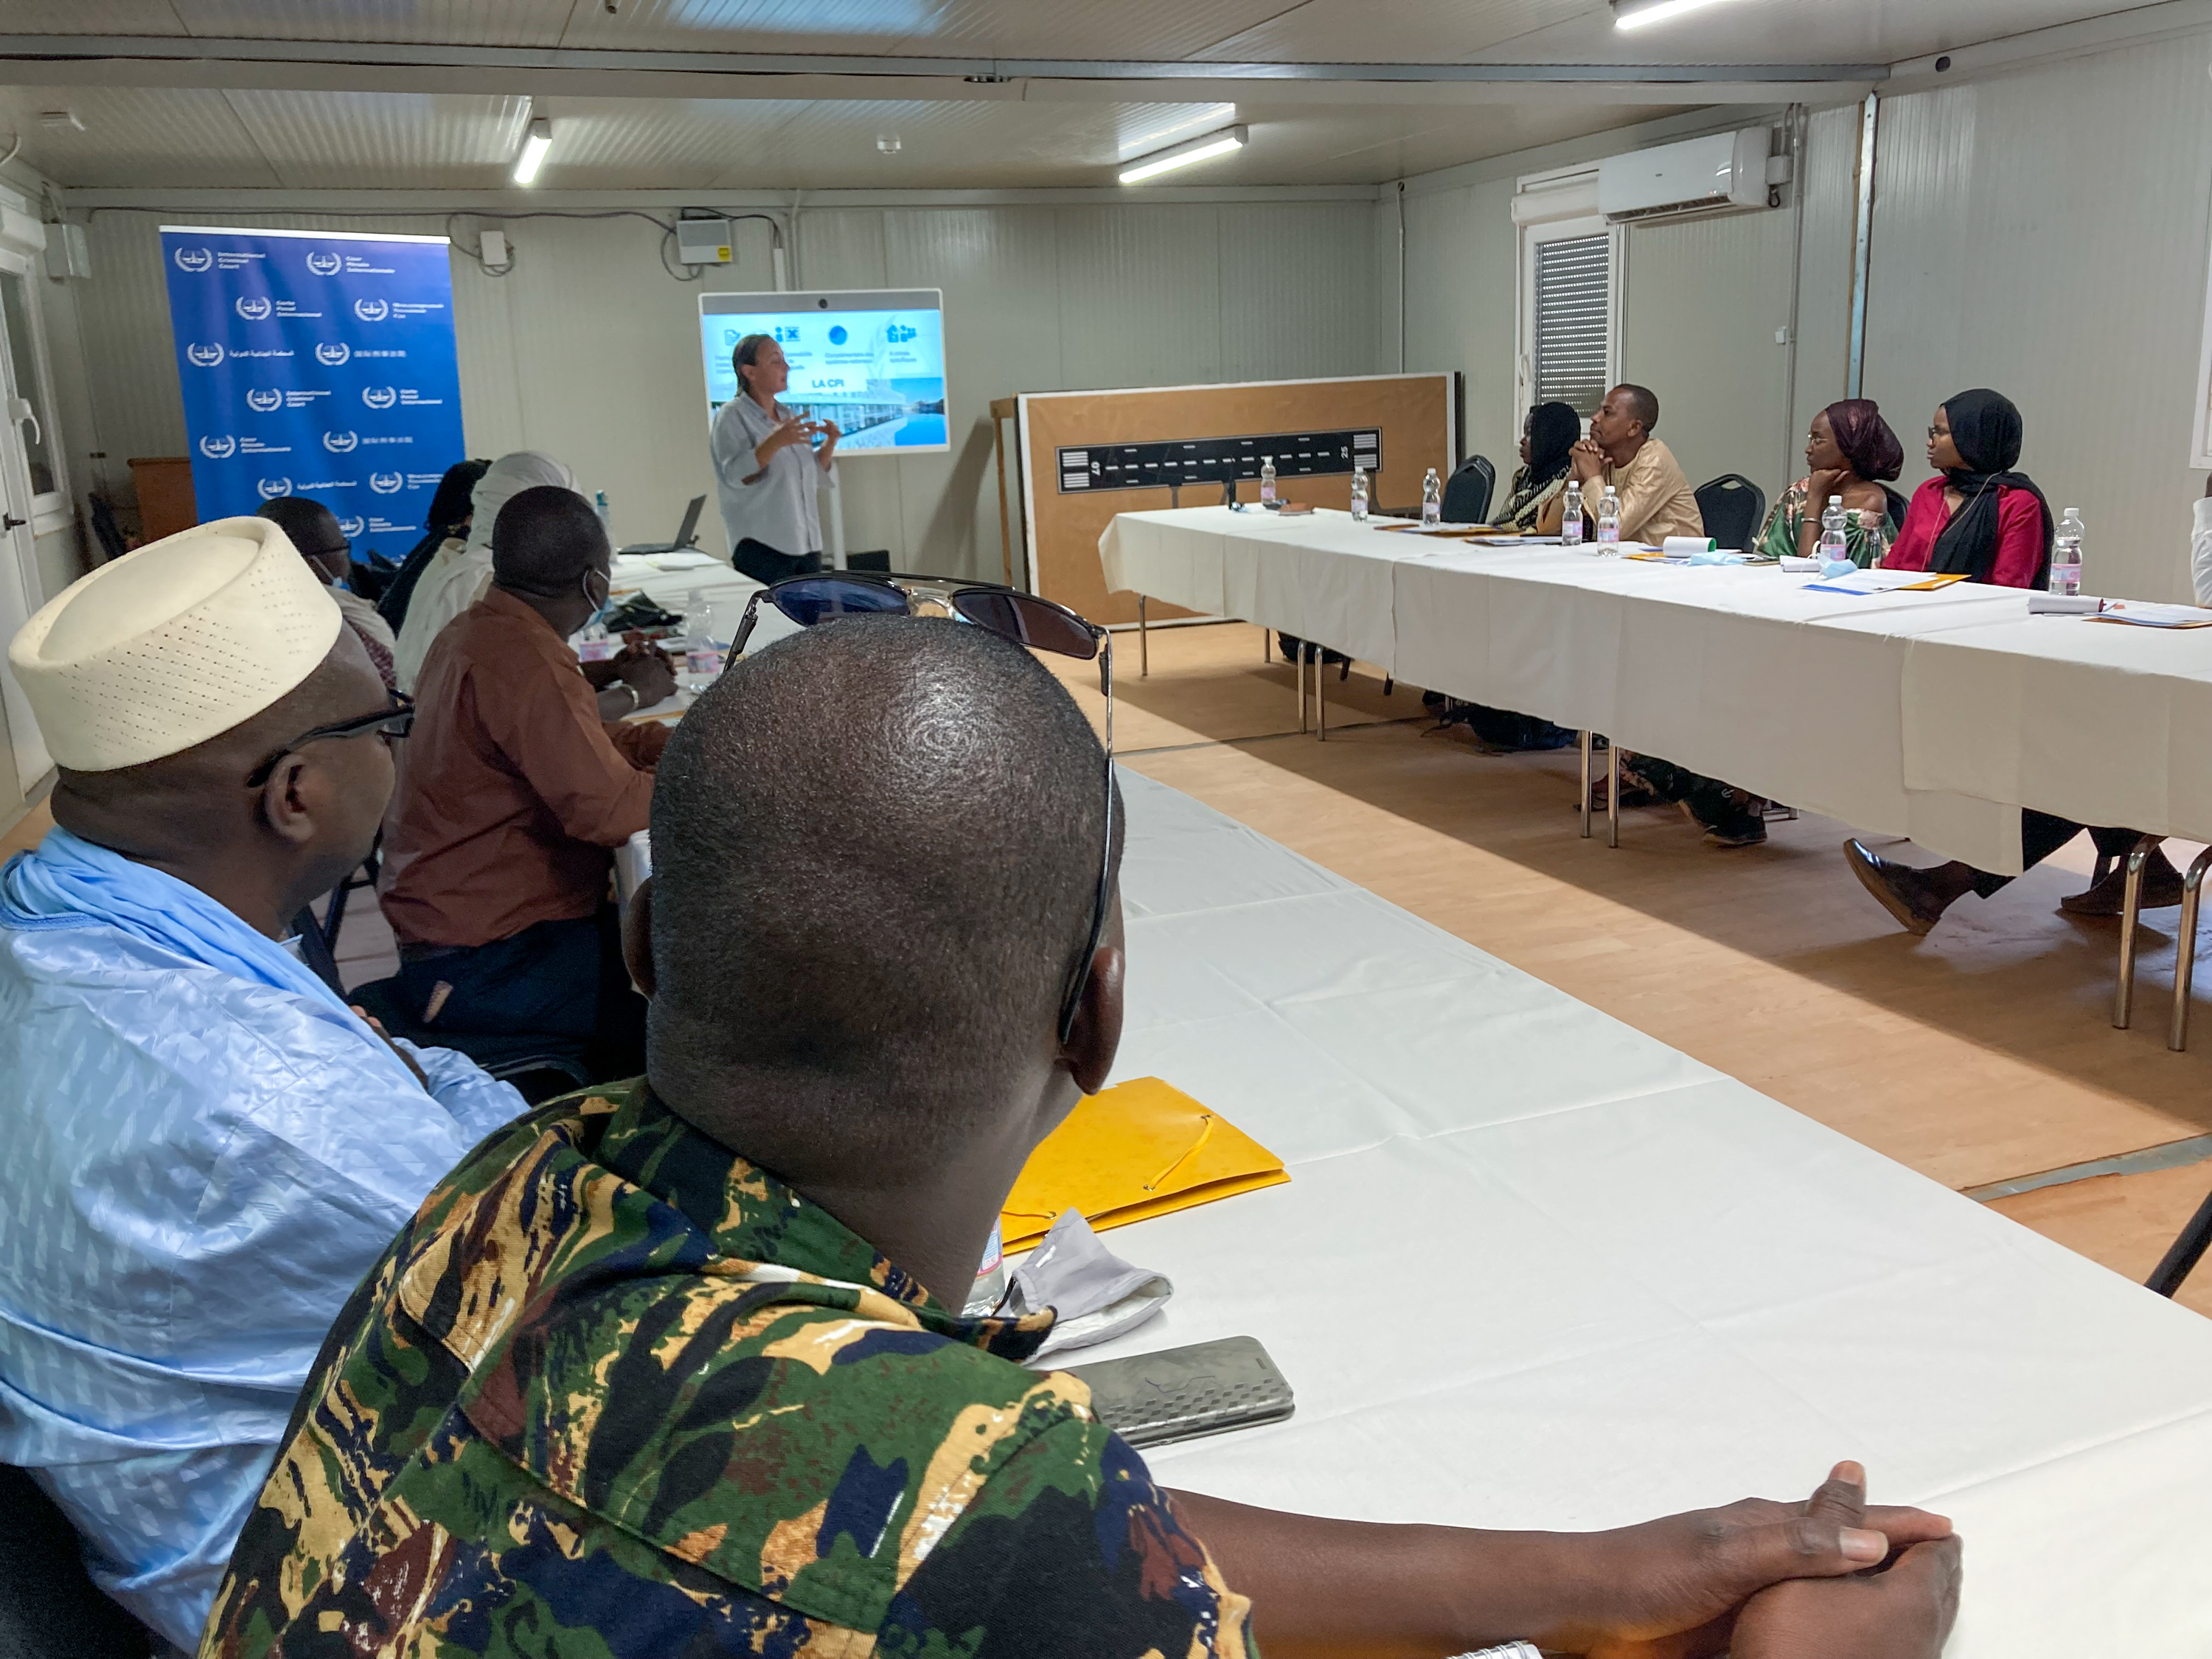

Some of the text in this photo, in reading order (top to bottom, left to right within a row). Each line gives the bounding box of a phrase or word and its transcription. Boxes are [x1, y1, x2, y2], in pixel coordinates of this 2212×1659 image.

[812, 379, 826, 389] LA
[1340, 446, 1349, 459] 25
[1091, 462, 1101, 476] 07
